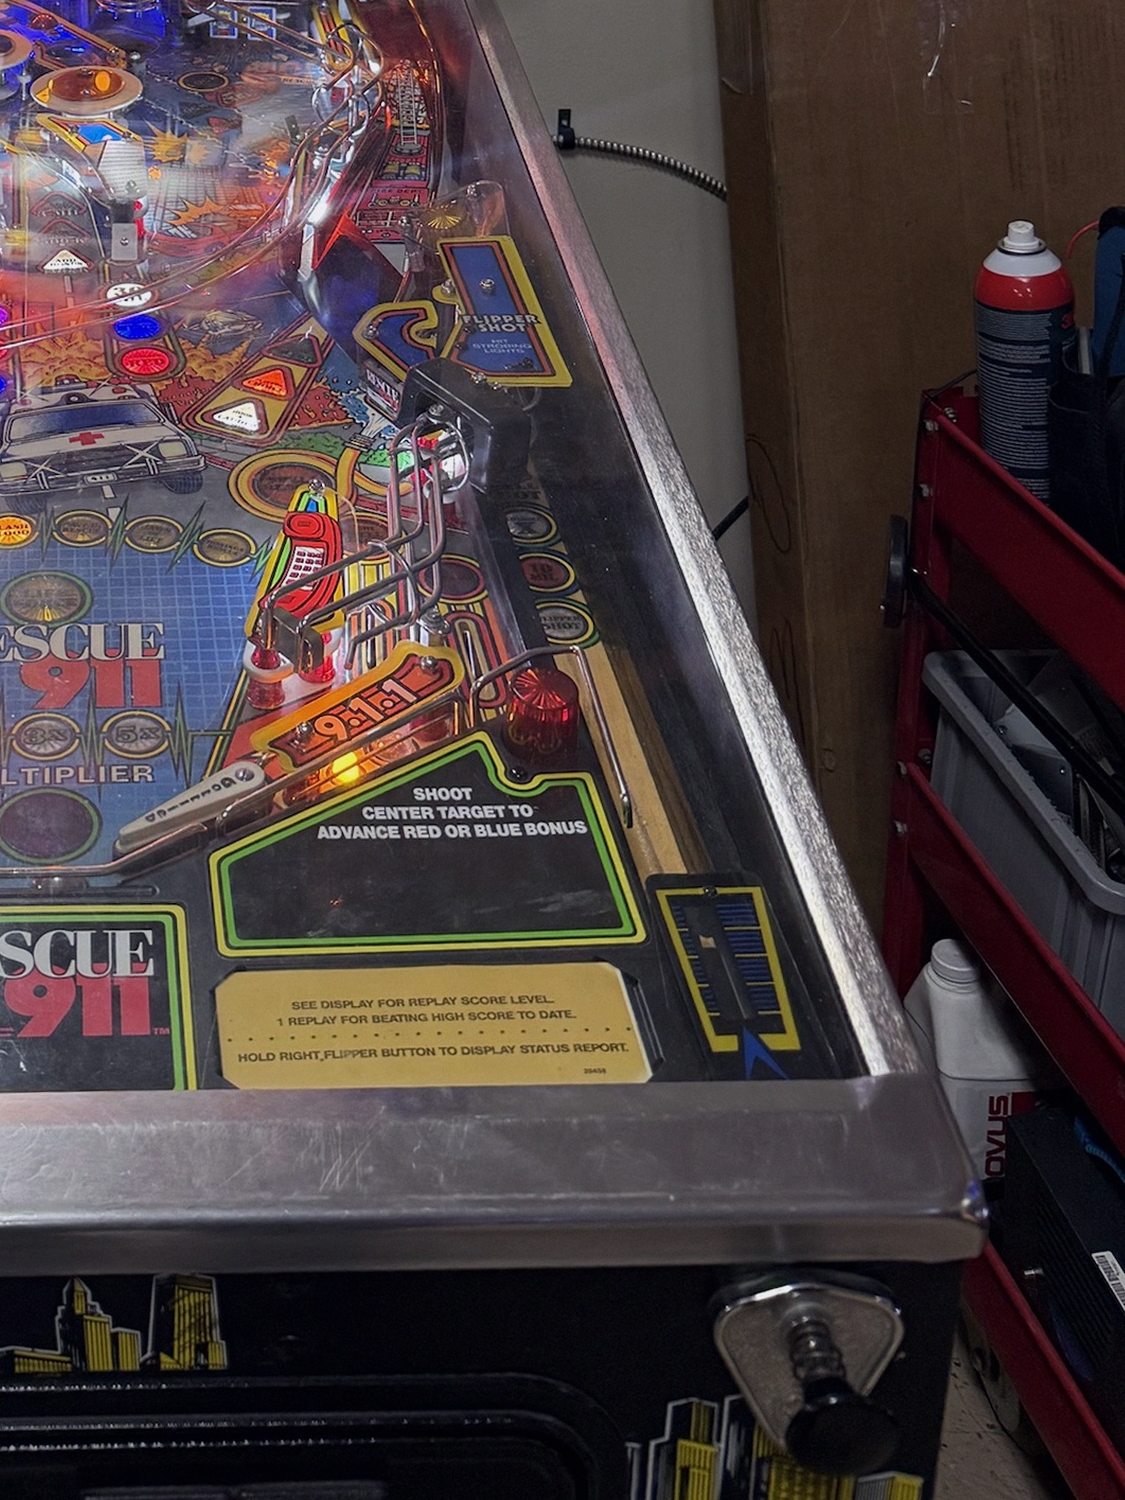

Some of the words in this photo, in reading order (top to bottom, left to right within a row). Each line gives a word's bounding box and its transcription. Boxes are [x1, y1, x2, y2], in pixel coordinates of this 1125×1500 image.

[462, 314, 538, 324] FLIPPER
[479, 323, 527, 332] SHOT
[541, 615, 581, 623] LIPPER
[19, 648, 163, 710] 911
[412, 786, 473, 801] SHOOT
[361, 806, 434, 821] CENTER
[436, 804, 506, 820] TARGET
[508, 804, 534, 818] TO
[316, 824, 401, 839] ADVANCE
[404, 824, 442, 839] RED
[444, 823, 472, 838] OR
[473, 822, 523, 838] BLUE
[526, 820, 588, 836] BONUS
[3, 962, 151, 1039] 911
[292, 1000, 317, 1011] SEE
[321, 998, 374, 1010] DISPLAY
[378, 997, 405, 1009] FOR
[408, 996, 457, 1008] REPLAY
[461, 994, 507, 1007] SCORE
[510, 994, 555, 1005] LEVEL.
[277, 1018, 283, 1027] 1
[288, 1015, 337, 1027] REPLAY
[341, 1014, 368, 1025] FOR
[372, 1012, 428, 1024] BEATING
[431, 1011, 465, 1023] HIGH
[468, 1010, 515, 1022] SCORE
[517, 1010, 536, 1021] TO
[538, 1008, 576, 1020] DATE.
[238, 1051, 276, 1063] HOLD
[279, 1050, 320, 1062] RIGHT
[324, 1048, 378, 1060] FLIPPER
[381, 1046, 436, 1058] BUTTON
[438, 1045, 458, 1057] TO
[460, 1044, 516, 1056] DISPLAY
[519, 1043, 571, 1055] STATUS
[572, 1041, 629, 1054] REPORT.
